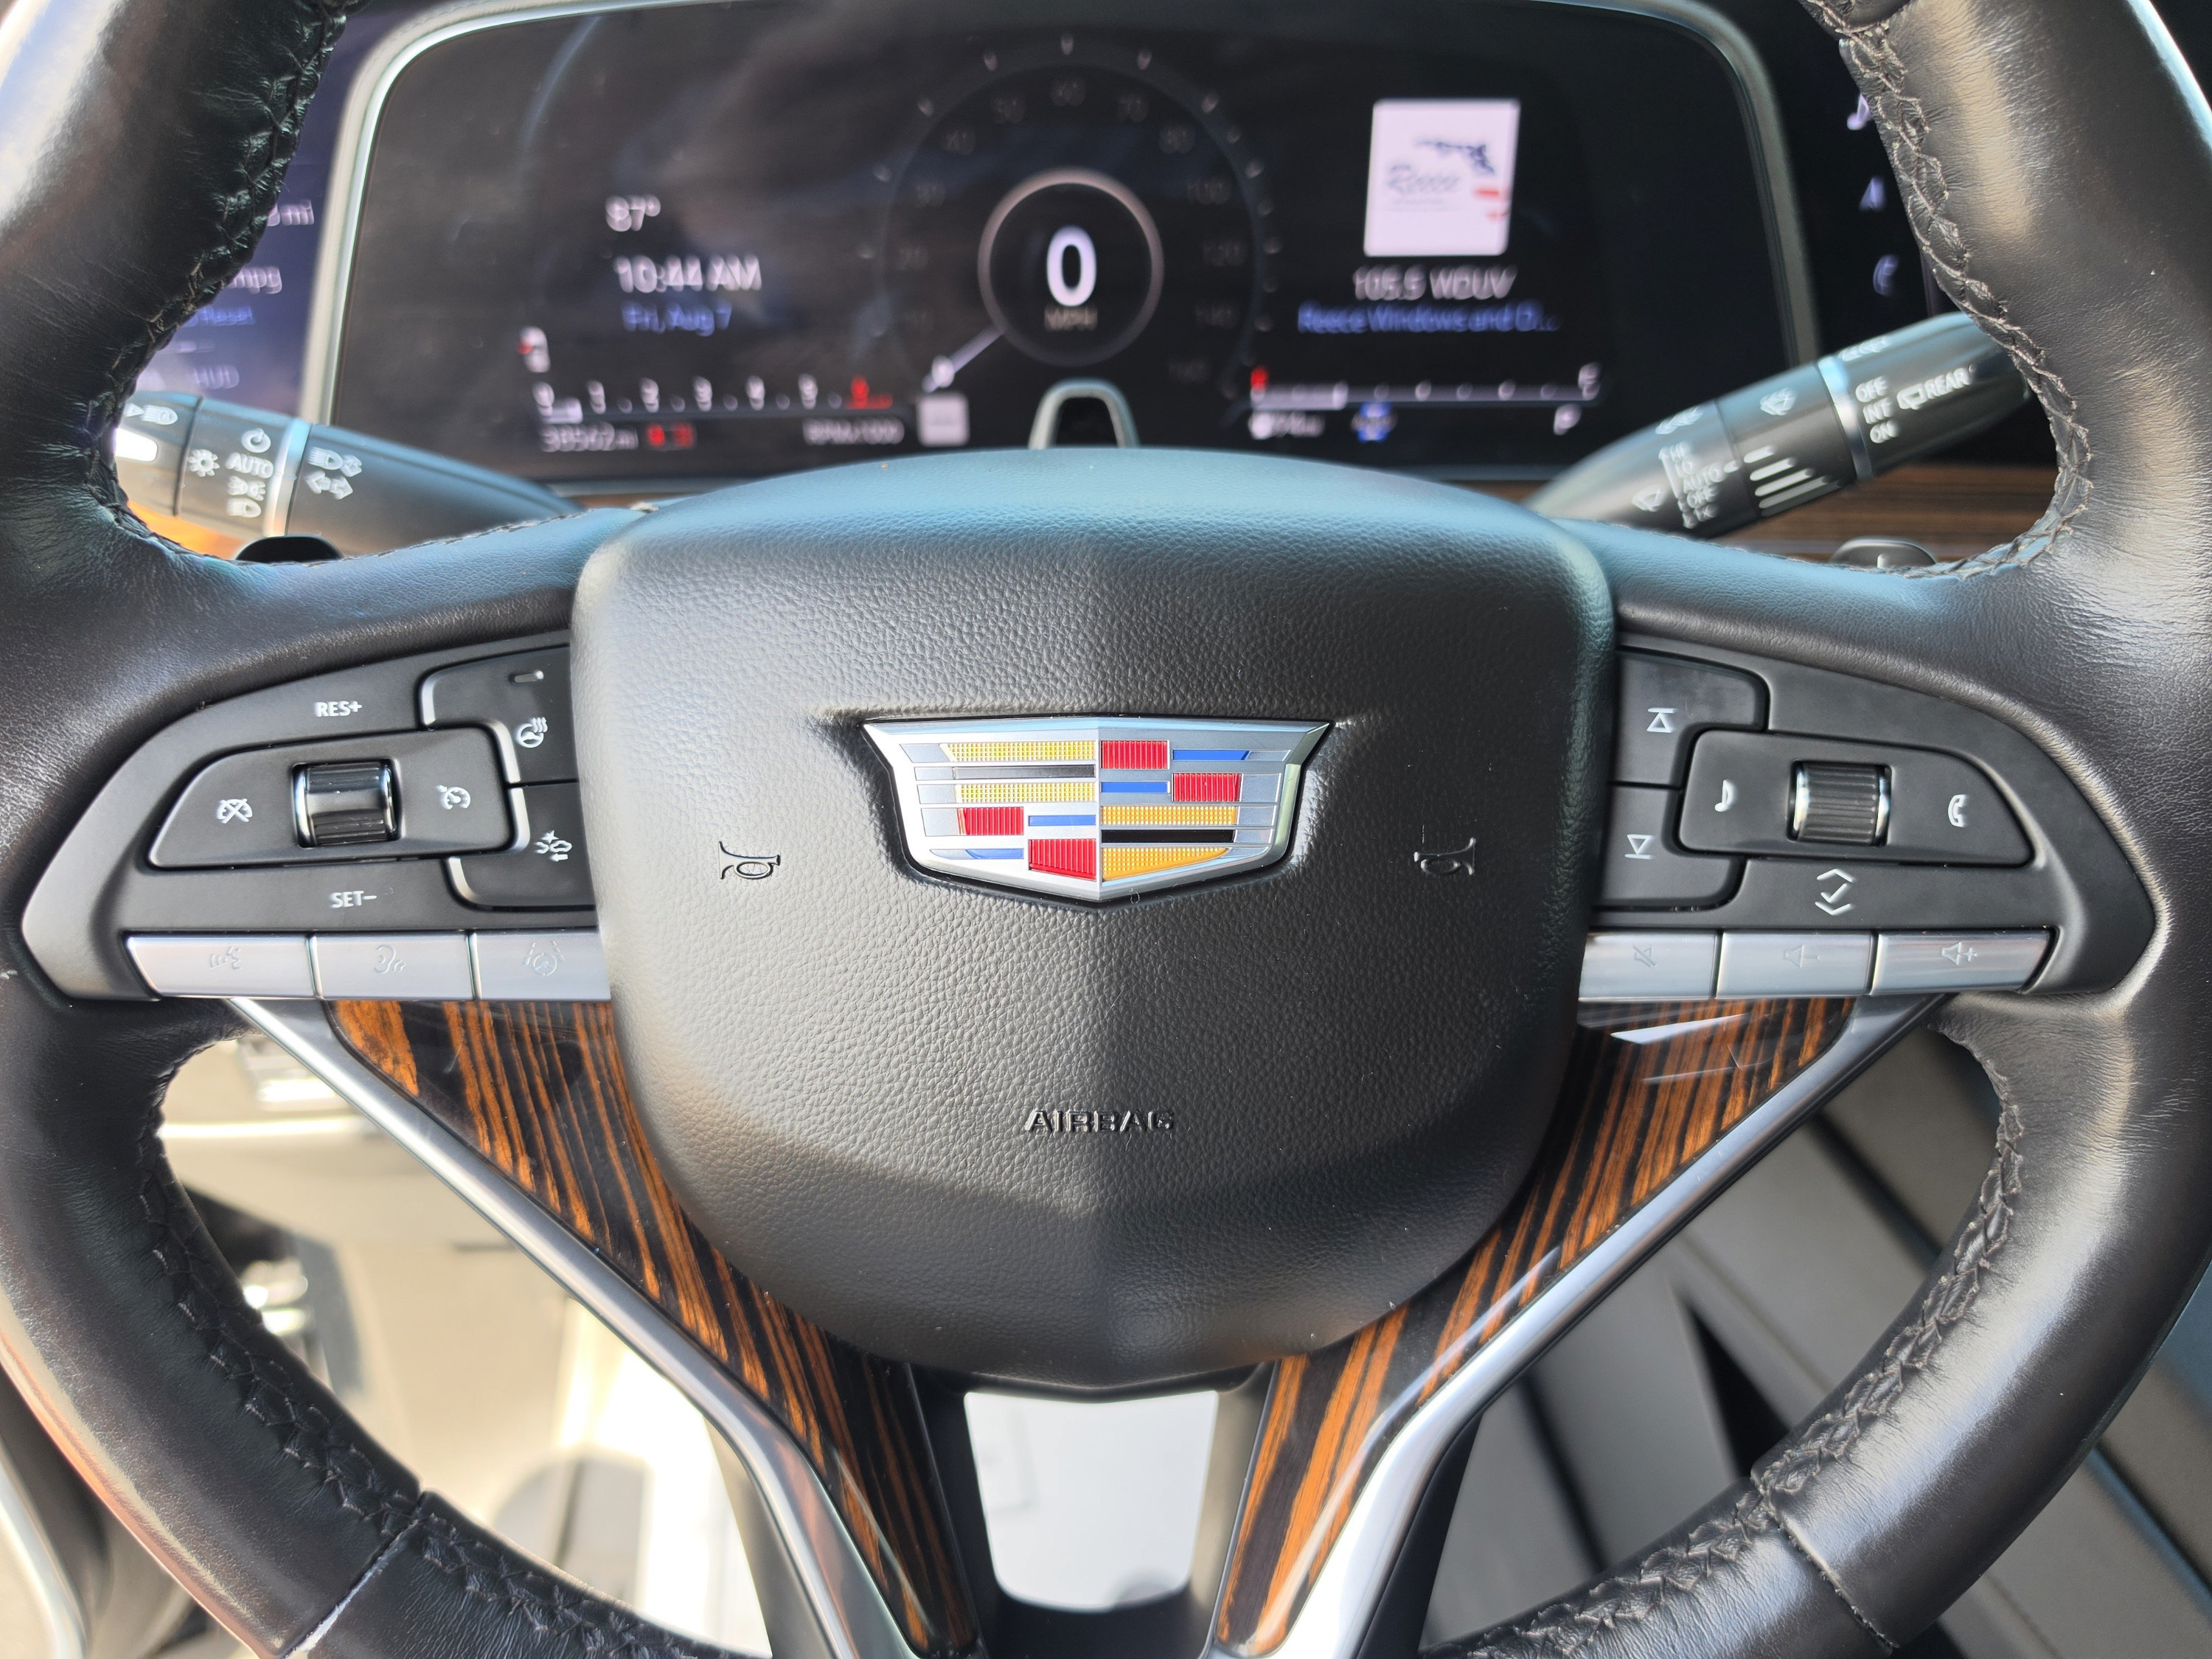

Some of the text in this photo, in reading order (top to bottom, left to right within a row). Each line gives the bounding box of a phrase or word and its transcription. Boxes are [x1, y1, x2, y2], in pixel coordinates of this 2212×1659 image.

[705, 253, 762, 291] AM
[1047, 225, 1097, 307] 0
[1855, 375, 1889, 403] OFF
[1924, 367, 1972, 400] REAR
[1863, 397, 1893, 425] INT
[1870, 420, 1900, 444] ON
[225, 451, 274, 479] AUTO
[1683, 462, 1726, 495] AUTO
[314, 700, 363, 717] RES+
[329, 889, 378, 909] SET-
[1024, 1109, 1175, 1133] AIRBAG
